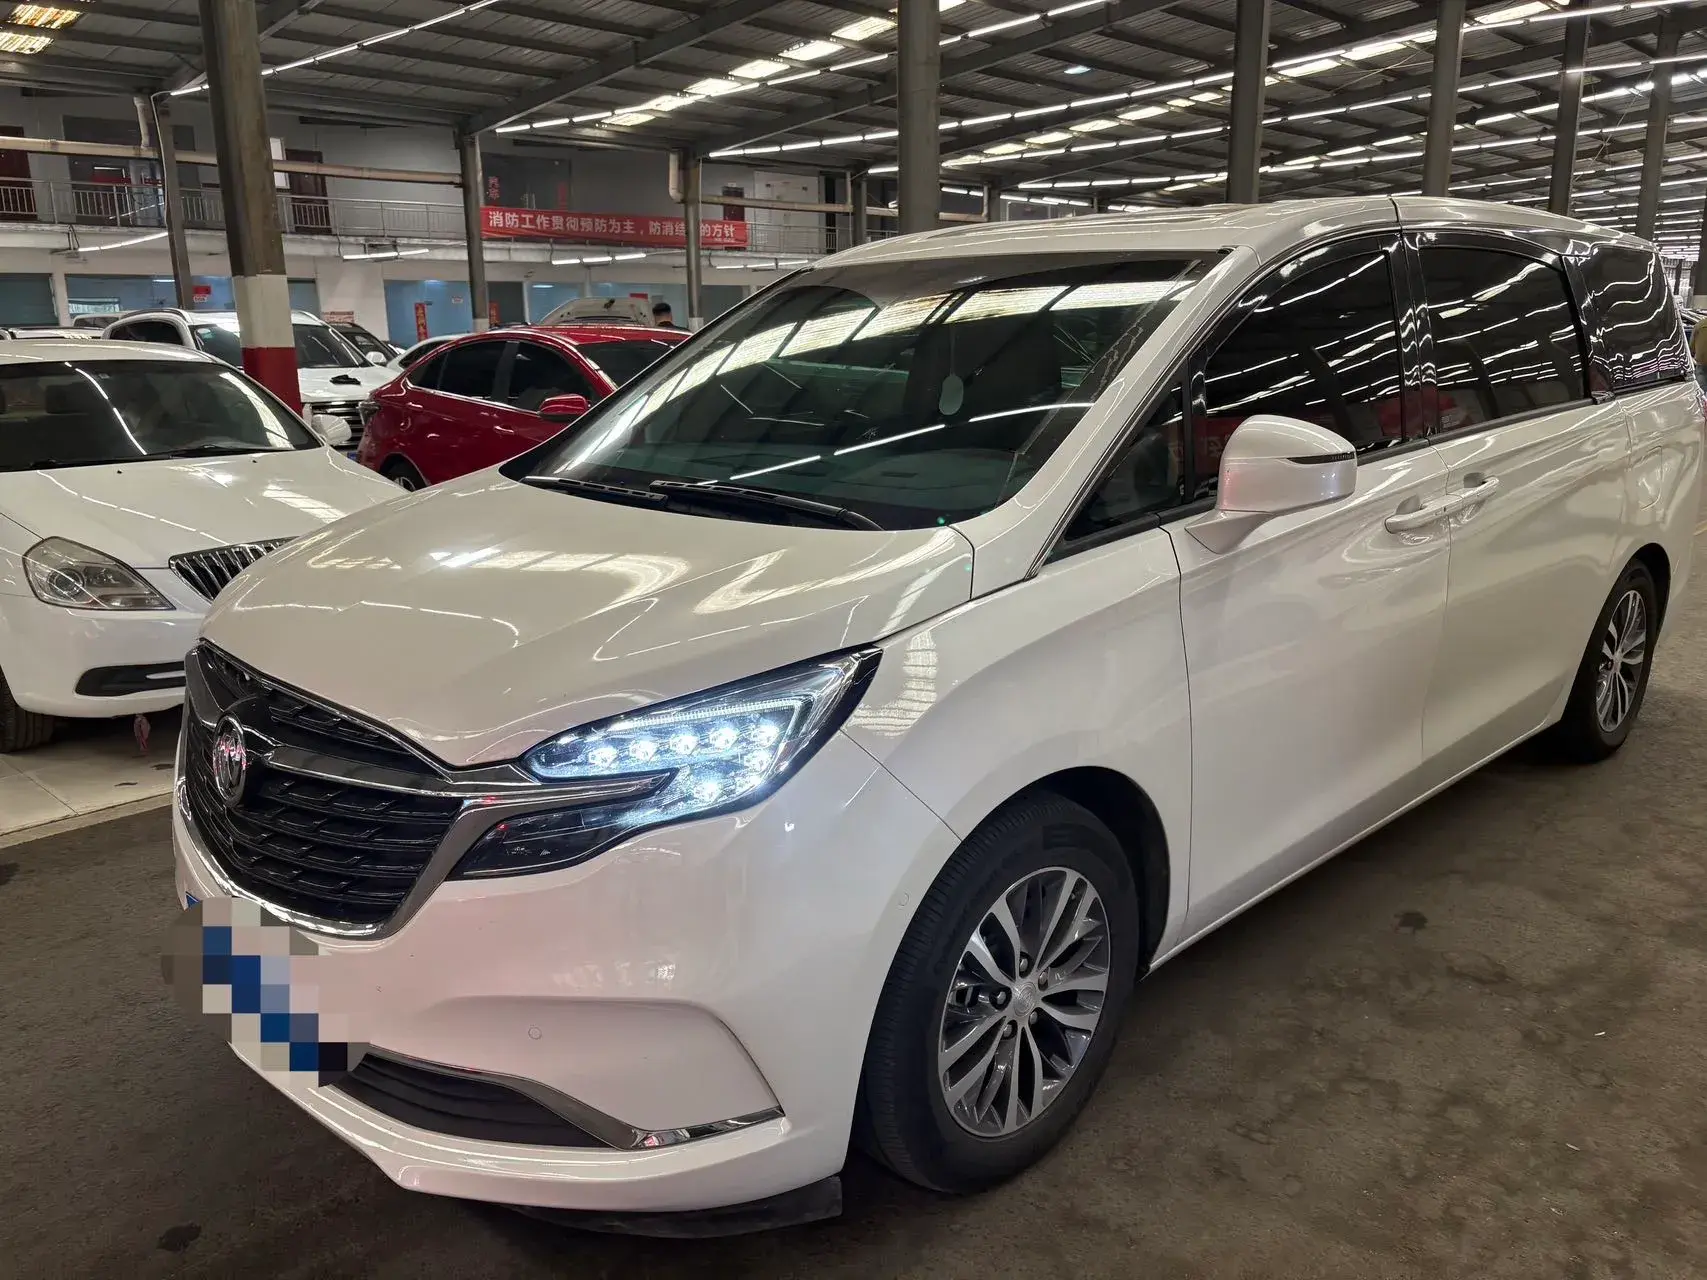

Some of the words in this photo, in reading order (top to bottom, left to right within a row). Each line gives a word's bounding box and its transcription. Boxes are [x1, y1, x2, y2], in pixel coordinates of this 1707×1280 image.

[488, 210, 736, 238] 消防工作贯彻预防为主，防消结的方针
